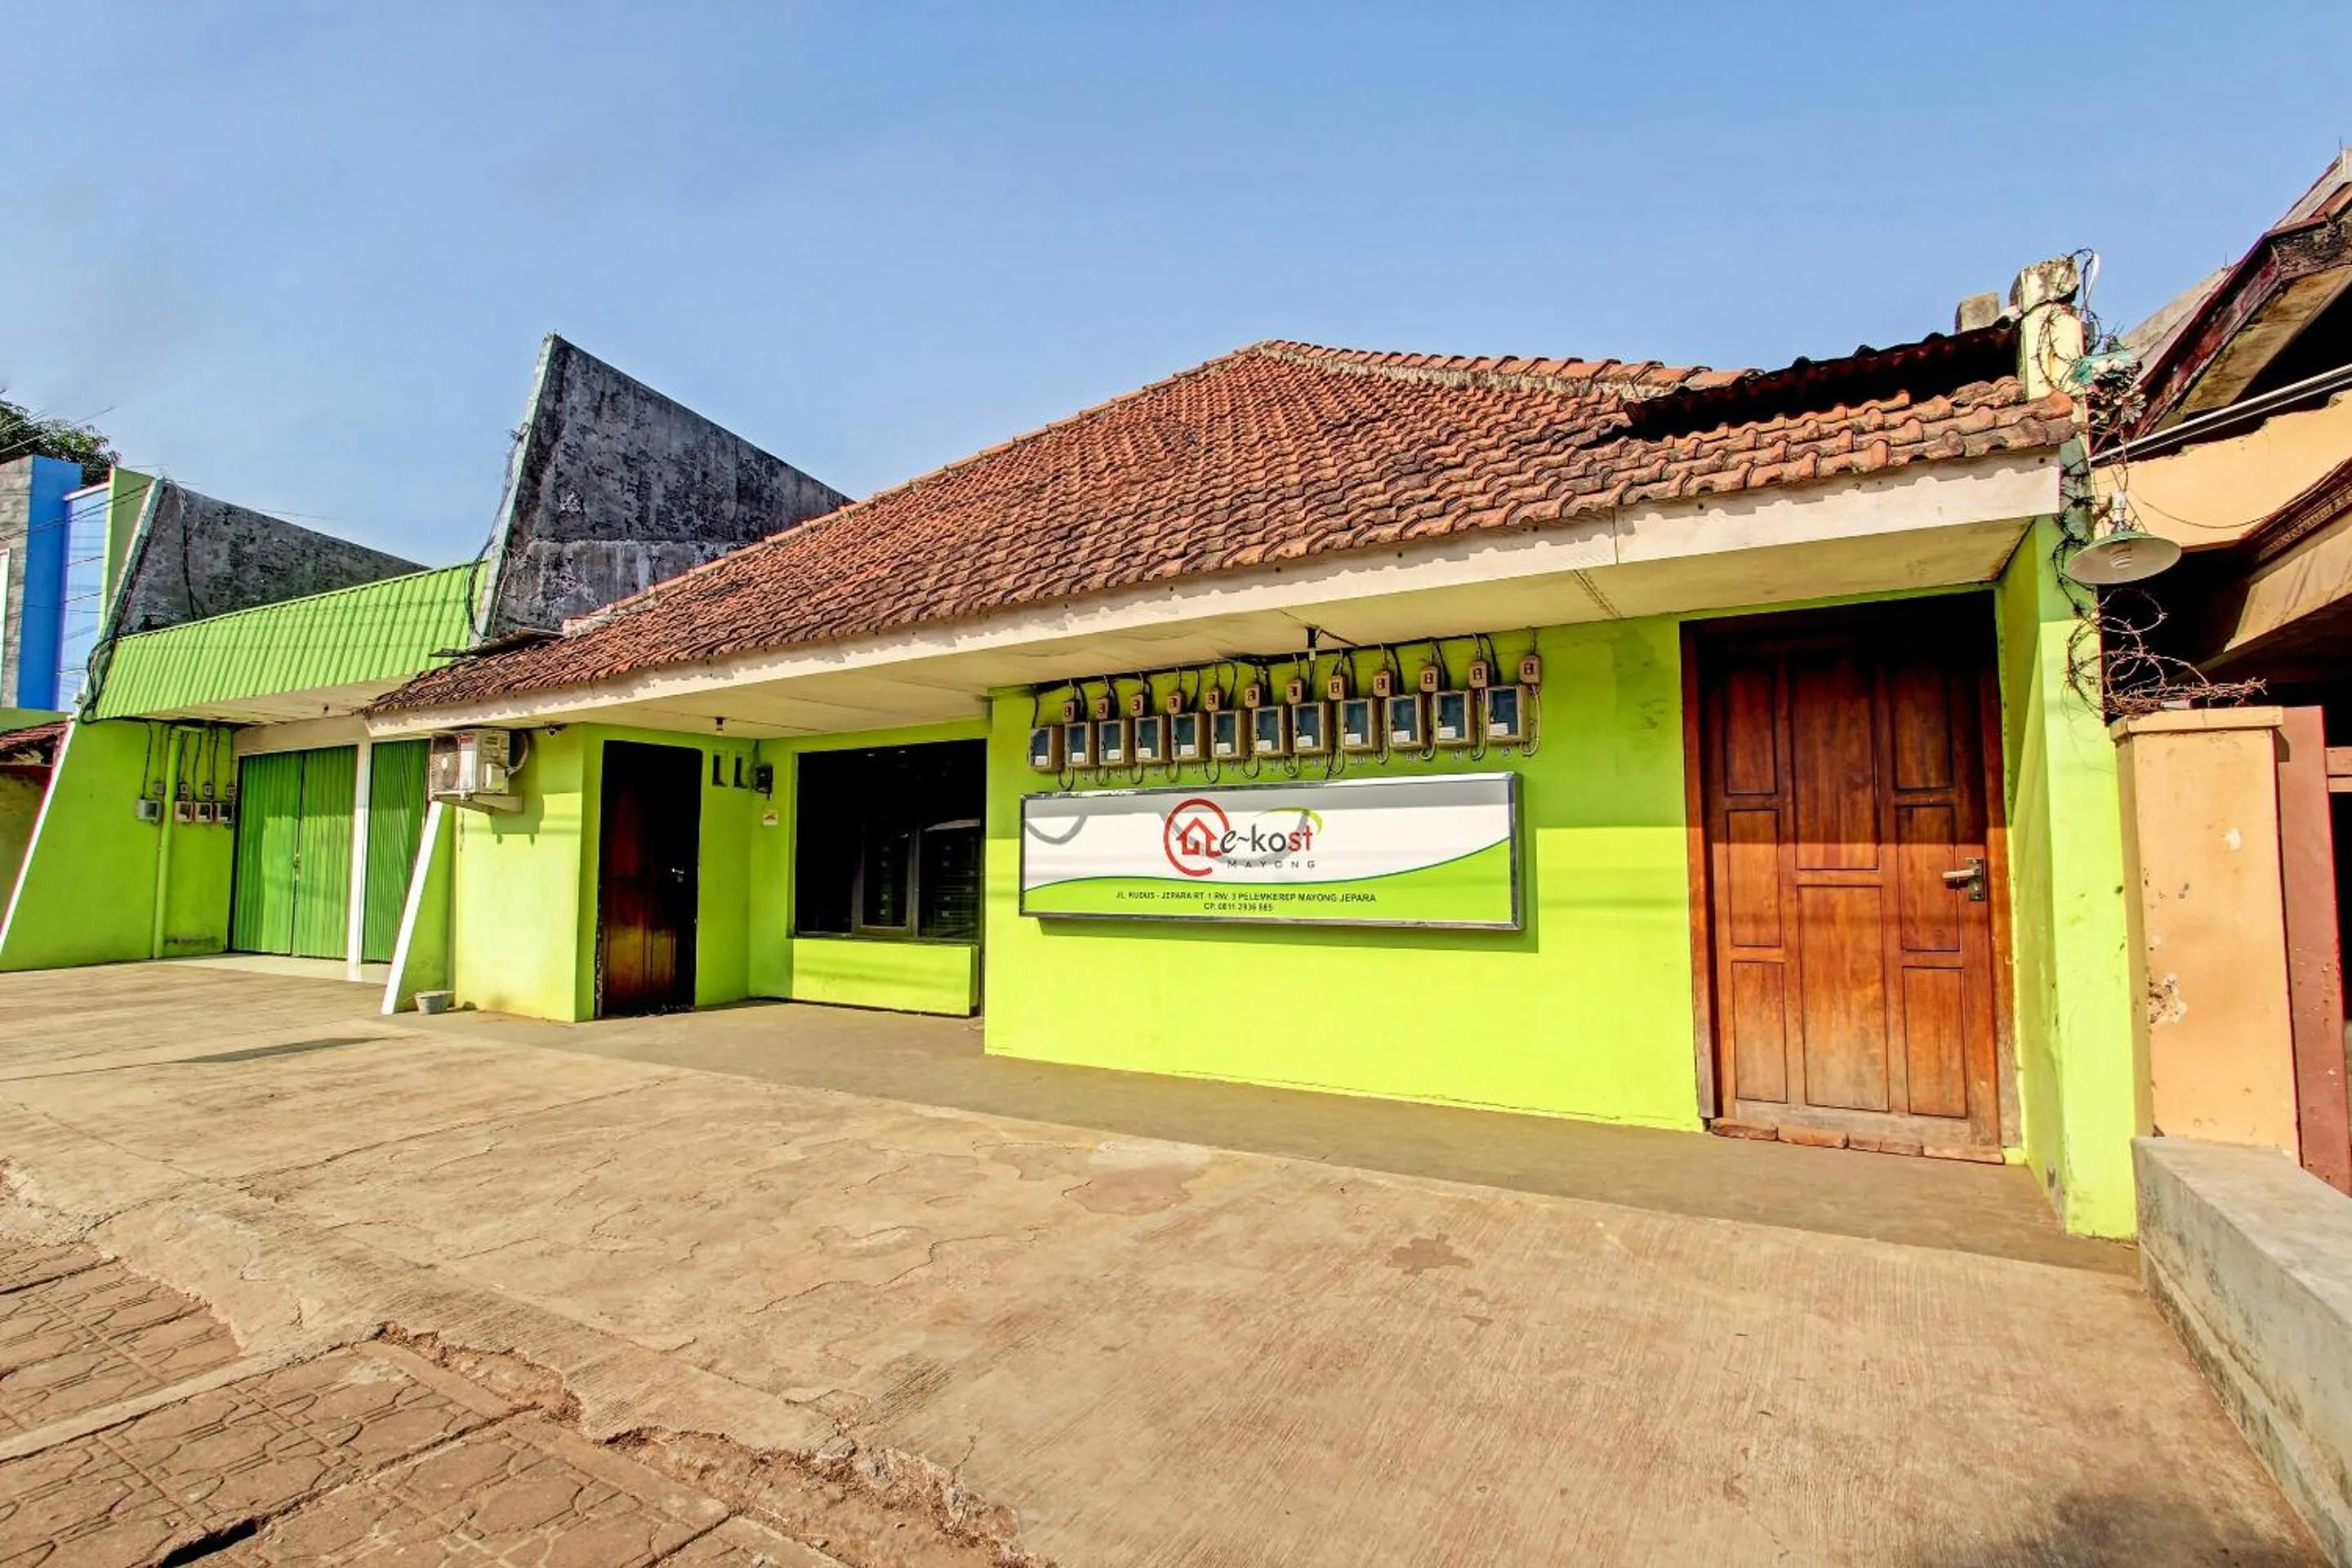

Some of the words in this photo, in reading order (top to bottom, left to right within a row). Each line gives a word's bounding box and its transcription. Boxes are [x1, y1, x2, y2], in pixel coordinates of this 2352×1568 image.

[1227, 860, 1316, 868] MAYONG
[1129, 891, 1155, 899] KUDUS
[1161, 891, 1192, 899] JEPARA
[1298, 893, 1337, 902] MAYONG
[1339, 893, 1377, 902] JEPARA
